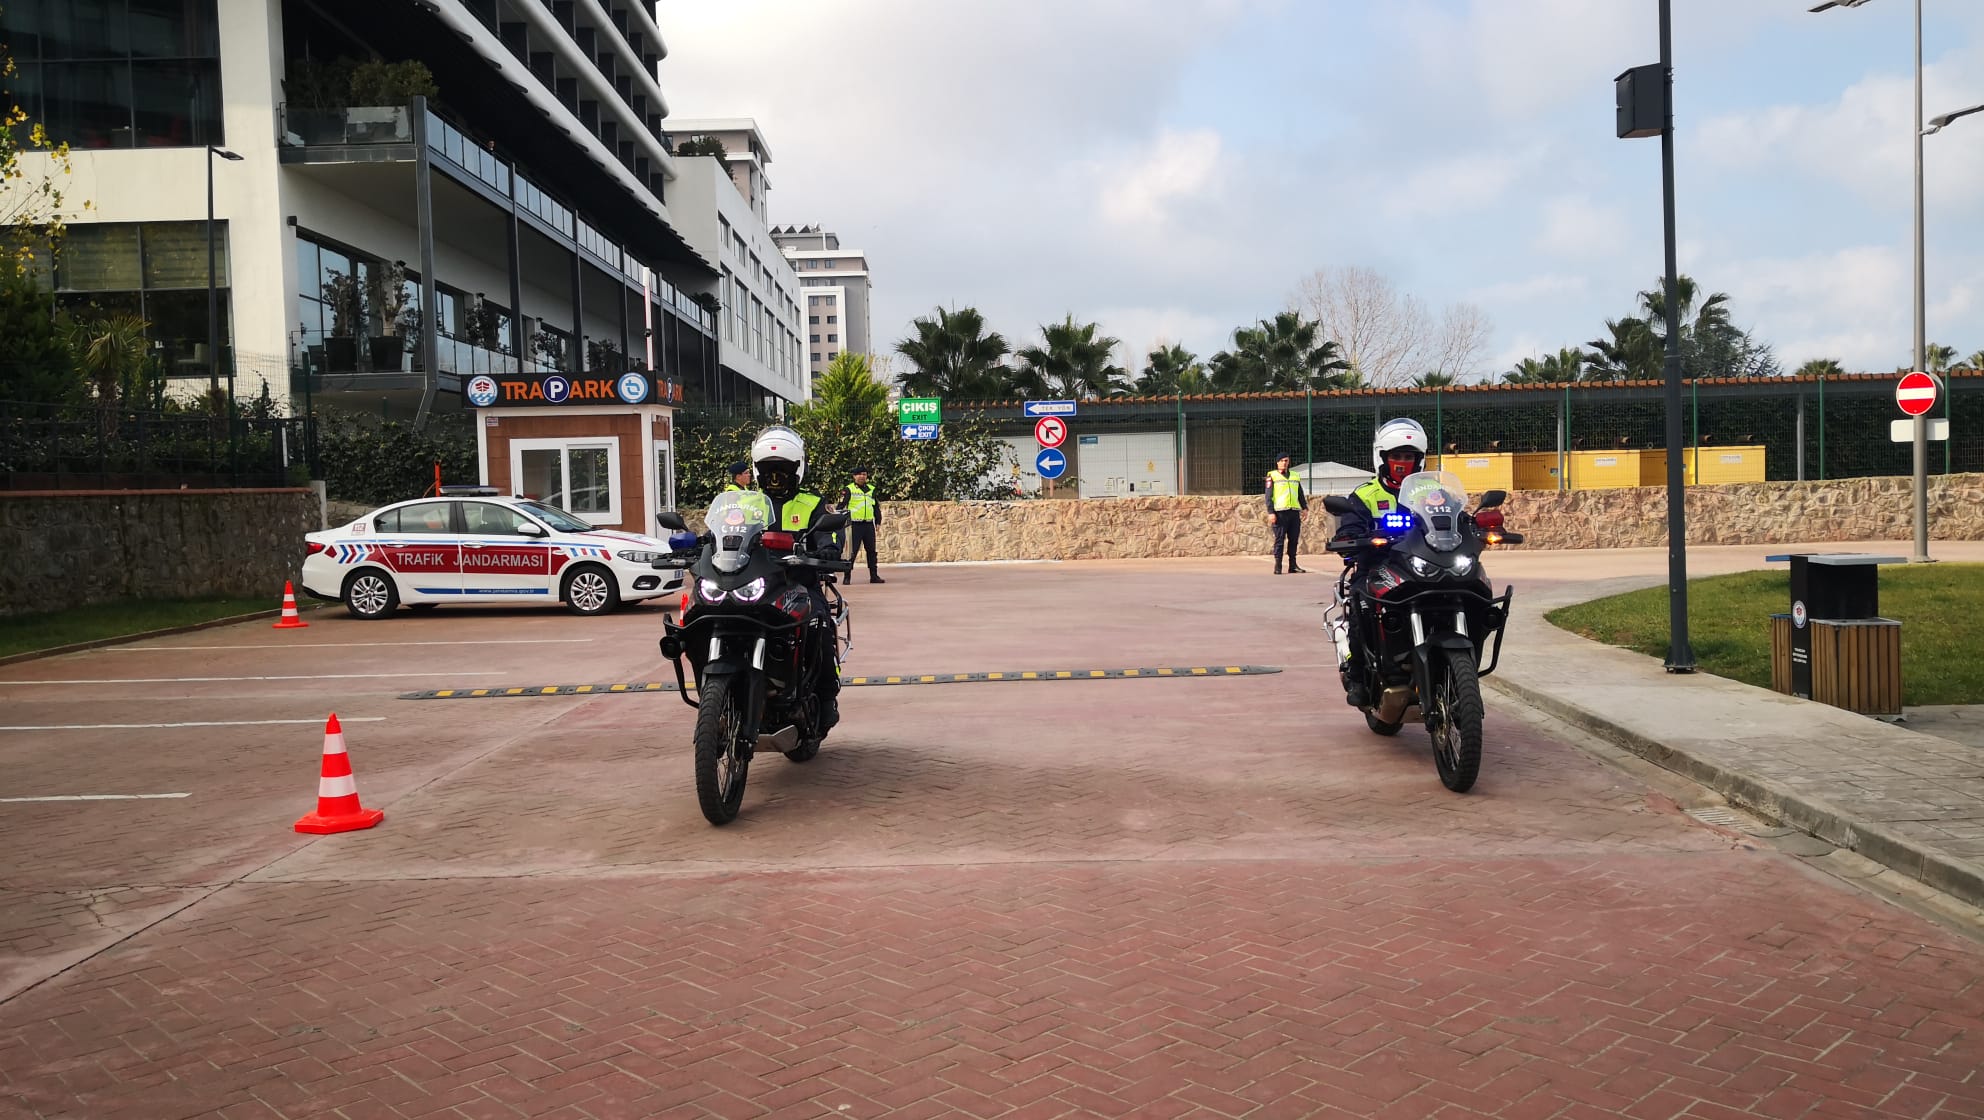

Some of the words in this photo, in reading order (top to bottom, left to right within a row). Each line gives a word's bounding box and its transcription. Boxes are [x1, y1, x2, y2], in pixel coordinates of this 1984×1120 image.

[500, 376, 615, 402] TRAPARK
[656, 378, 684, 402] TRAPARK
[902, 402, 937, 414] ÇIKIŞ
[453, 553, 543, 567] JANDARMASI
